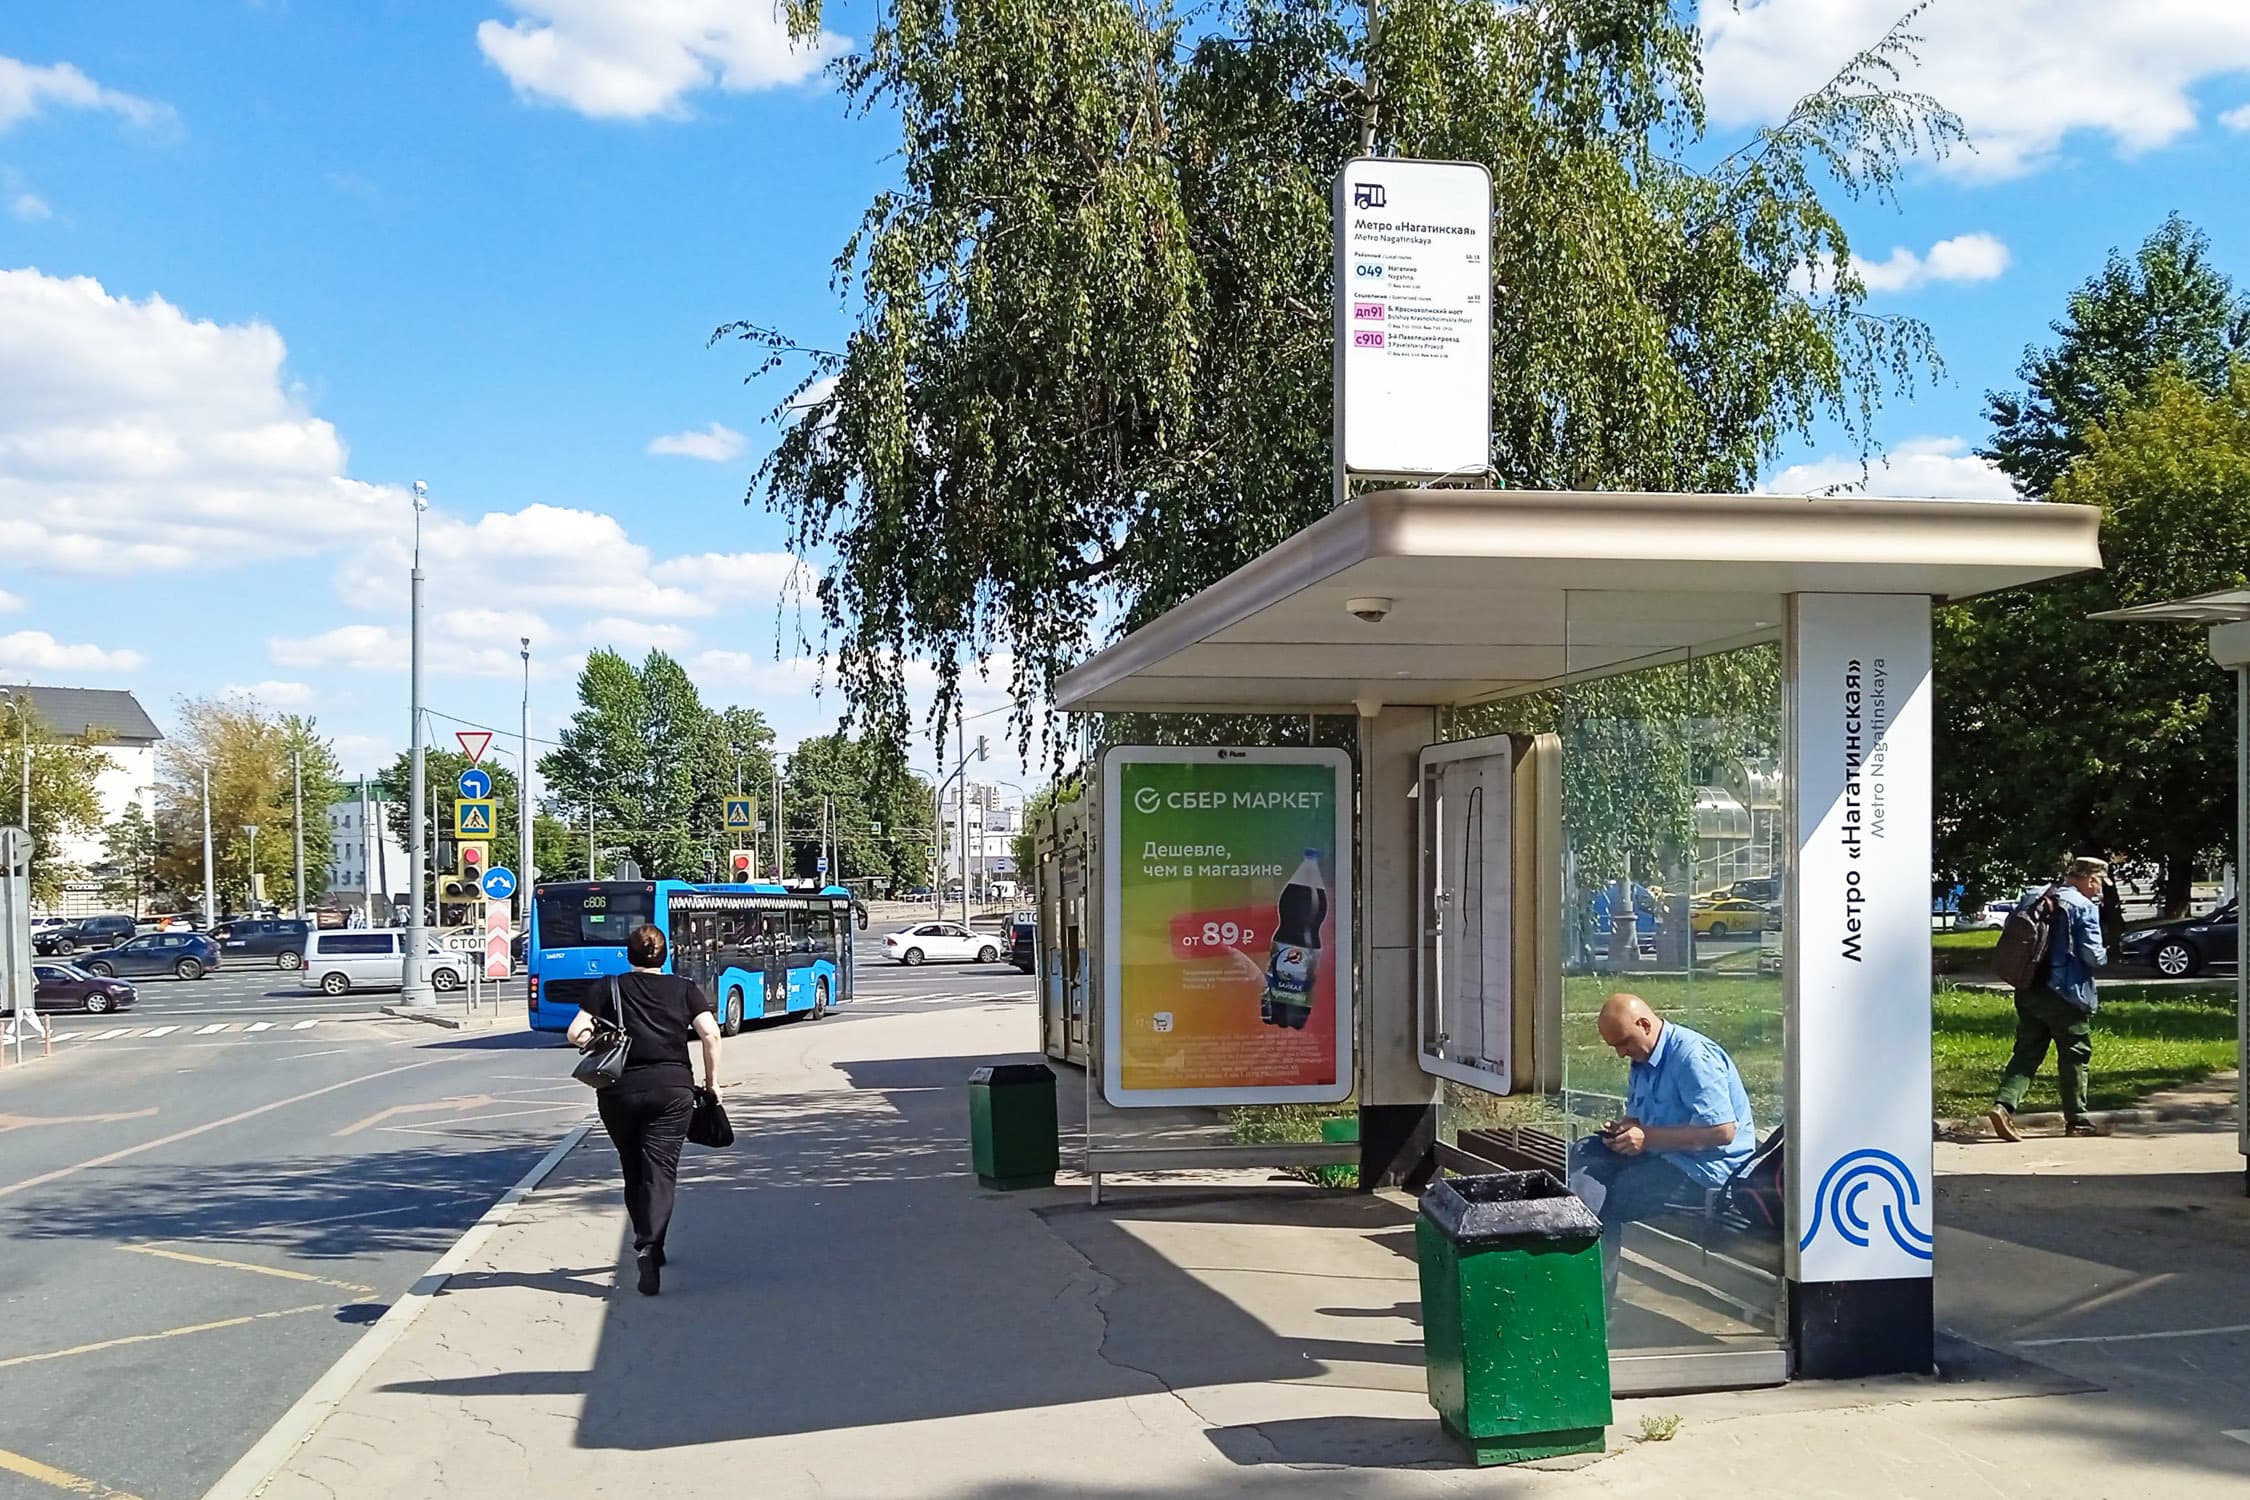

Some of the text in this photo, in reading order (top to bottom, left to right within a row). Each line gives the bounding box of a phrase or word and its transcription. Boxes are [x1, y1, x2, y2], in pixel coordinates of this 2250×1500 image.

[1354, 219, 1476, 235] Метро «Нагатинская»
[1354, 233, 1432, 245] Metro Nagatinskaya
[1355, 306, 1383, 318] дп91
[1355, 334, 1383, 346] с910
[1870, 658, 1889, 839] Metro Nagatinskaya
[1167, 791, 1324, 809] СБЕР МАРКЕТ
[1841, 659, 1866, 963] Метро «Нагатинская»
[1142, 841, 1232, 860] Дешевле,
[1143, 864, 1283, 876] чем в магазине
[1018, 912, 1038, 922] СТО
[1182, 936, 1200, 946] от
[1202, 922, 1239, 946] 89
[450, 938, 486, 949] СТОП
